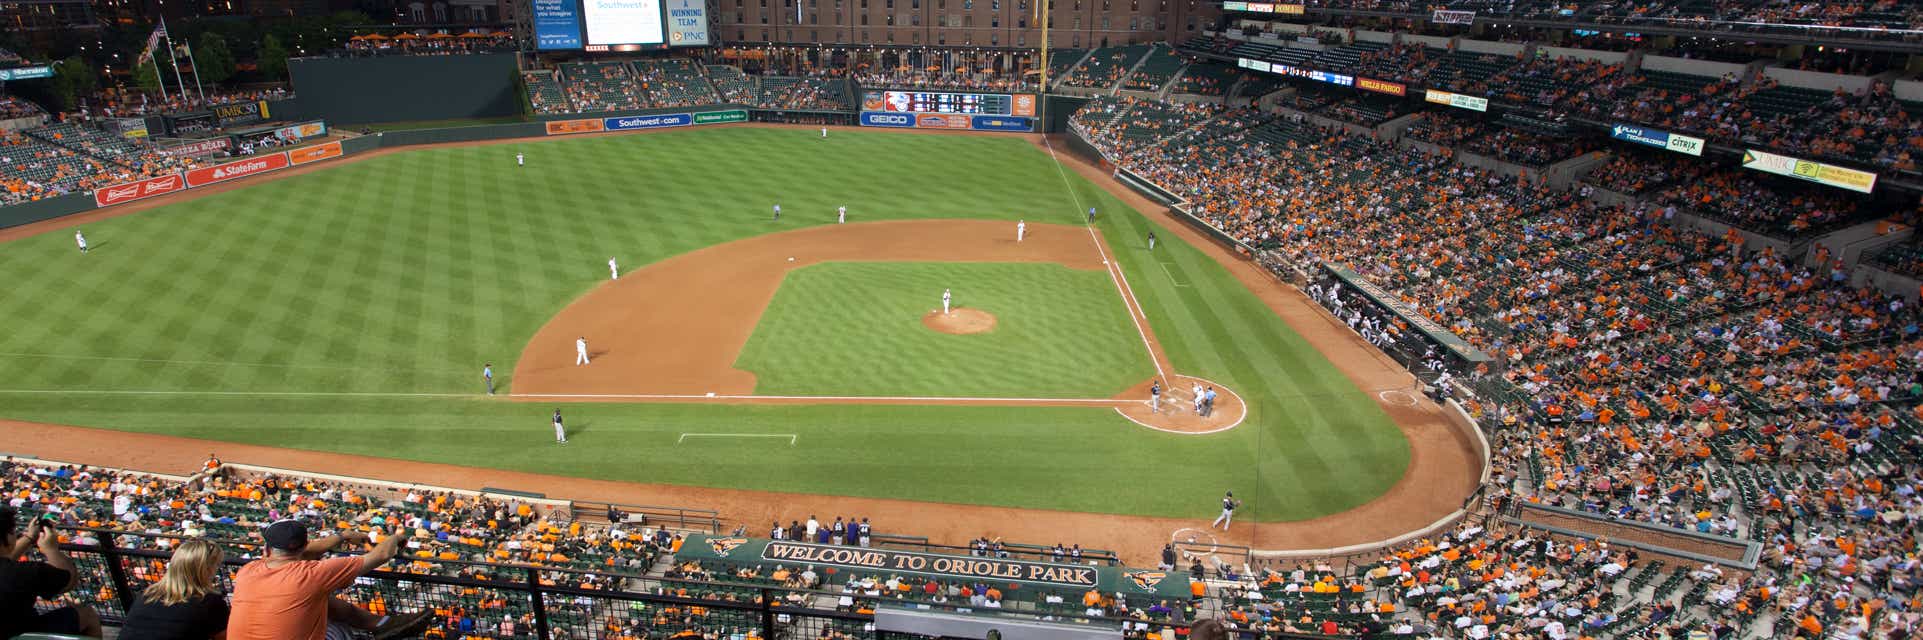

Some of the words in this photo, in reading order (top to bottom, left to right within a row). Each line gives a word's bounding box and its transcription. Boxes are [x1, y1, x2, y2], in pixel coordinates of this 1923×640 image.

[671, 9, 702, 17] WINNING
[678, 18, 697, 26] TEAM
[684, 32, 705, 41] PNC
[870, 115, 908, 124] GEICO
[771, 544, 887, 567] WELCOME
[893, 555, 927, 570] TO
[933, 558, 1022, 579] ORIOLE
[1030, 567, 1094, 585] PARK
